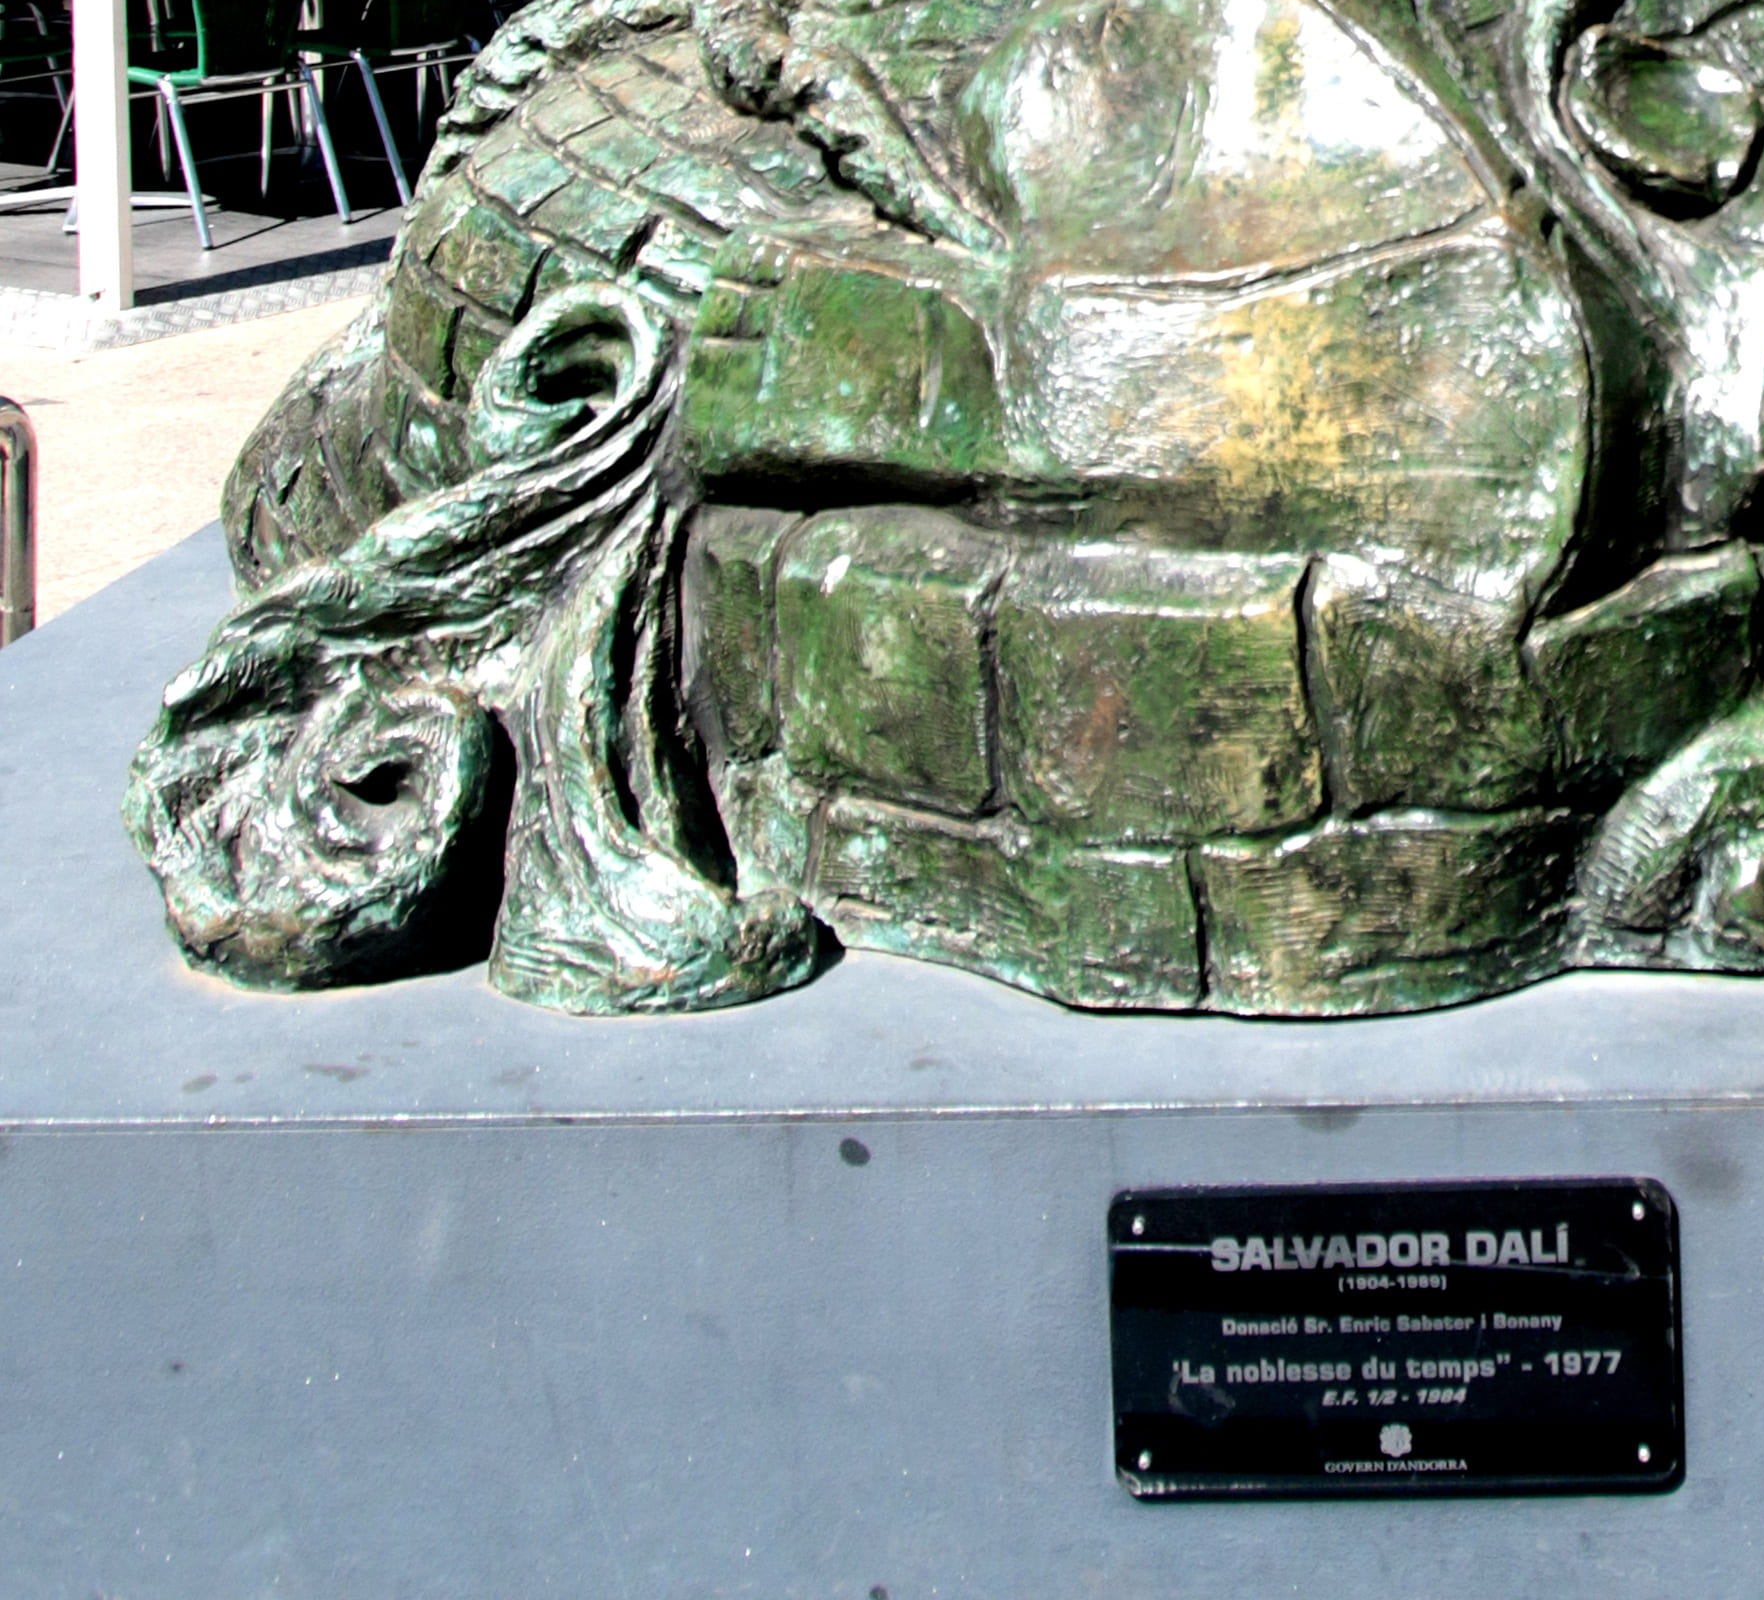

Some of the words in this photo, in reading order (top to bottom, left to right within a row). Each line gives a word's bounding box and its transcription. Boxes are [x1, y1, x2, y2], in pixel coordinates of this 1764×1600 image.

[1211, 1232, 1451, 1272] SALVADOR
[1465, 1222, 1569, 1266] DALÍ
[1338, 1274, 1447, 1292] (1904-1989)
[1221, 1316, 1298, 1336] Donació
[1304, 1317, 1332, 1335] Sr.
[1340, 1315, 1391, 1333] Enric
[1397, 1314, 1475, 1333] Sabater
[1480, 1313, 1487, 1330] i
[1493, 1313, 1563, 1333] Bonany
[1227, 1357, 1352, 1383] noblesse
[1362, 1356, 1396, 1380] du
[1544, 1351, 1622, 1375] 1977
[1416, 1388, 1467, 1405] 1984
[1325, 1461, 1384, 1473] GOVERN
[1386, 1459, 1468, 1473] D'ANDORRA
